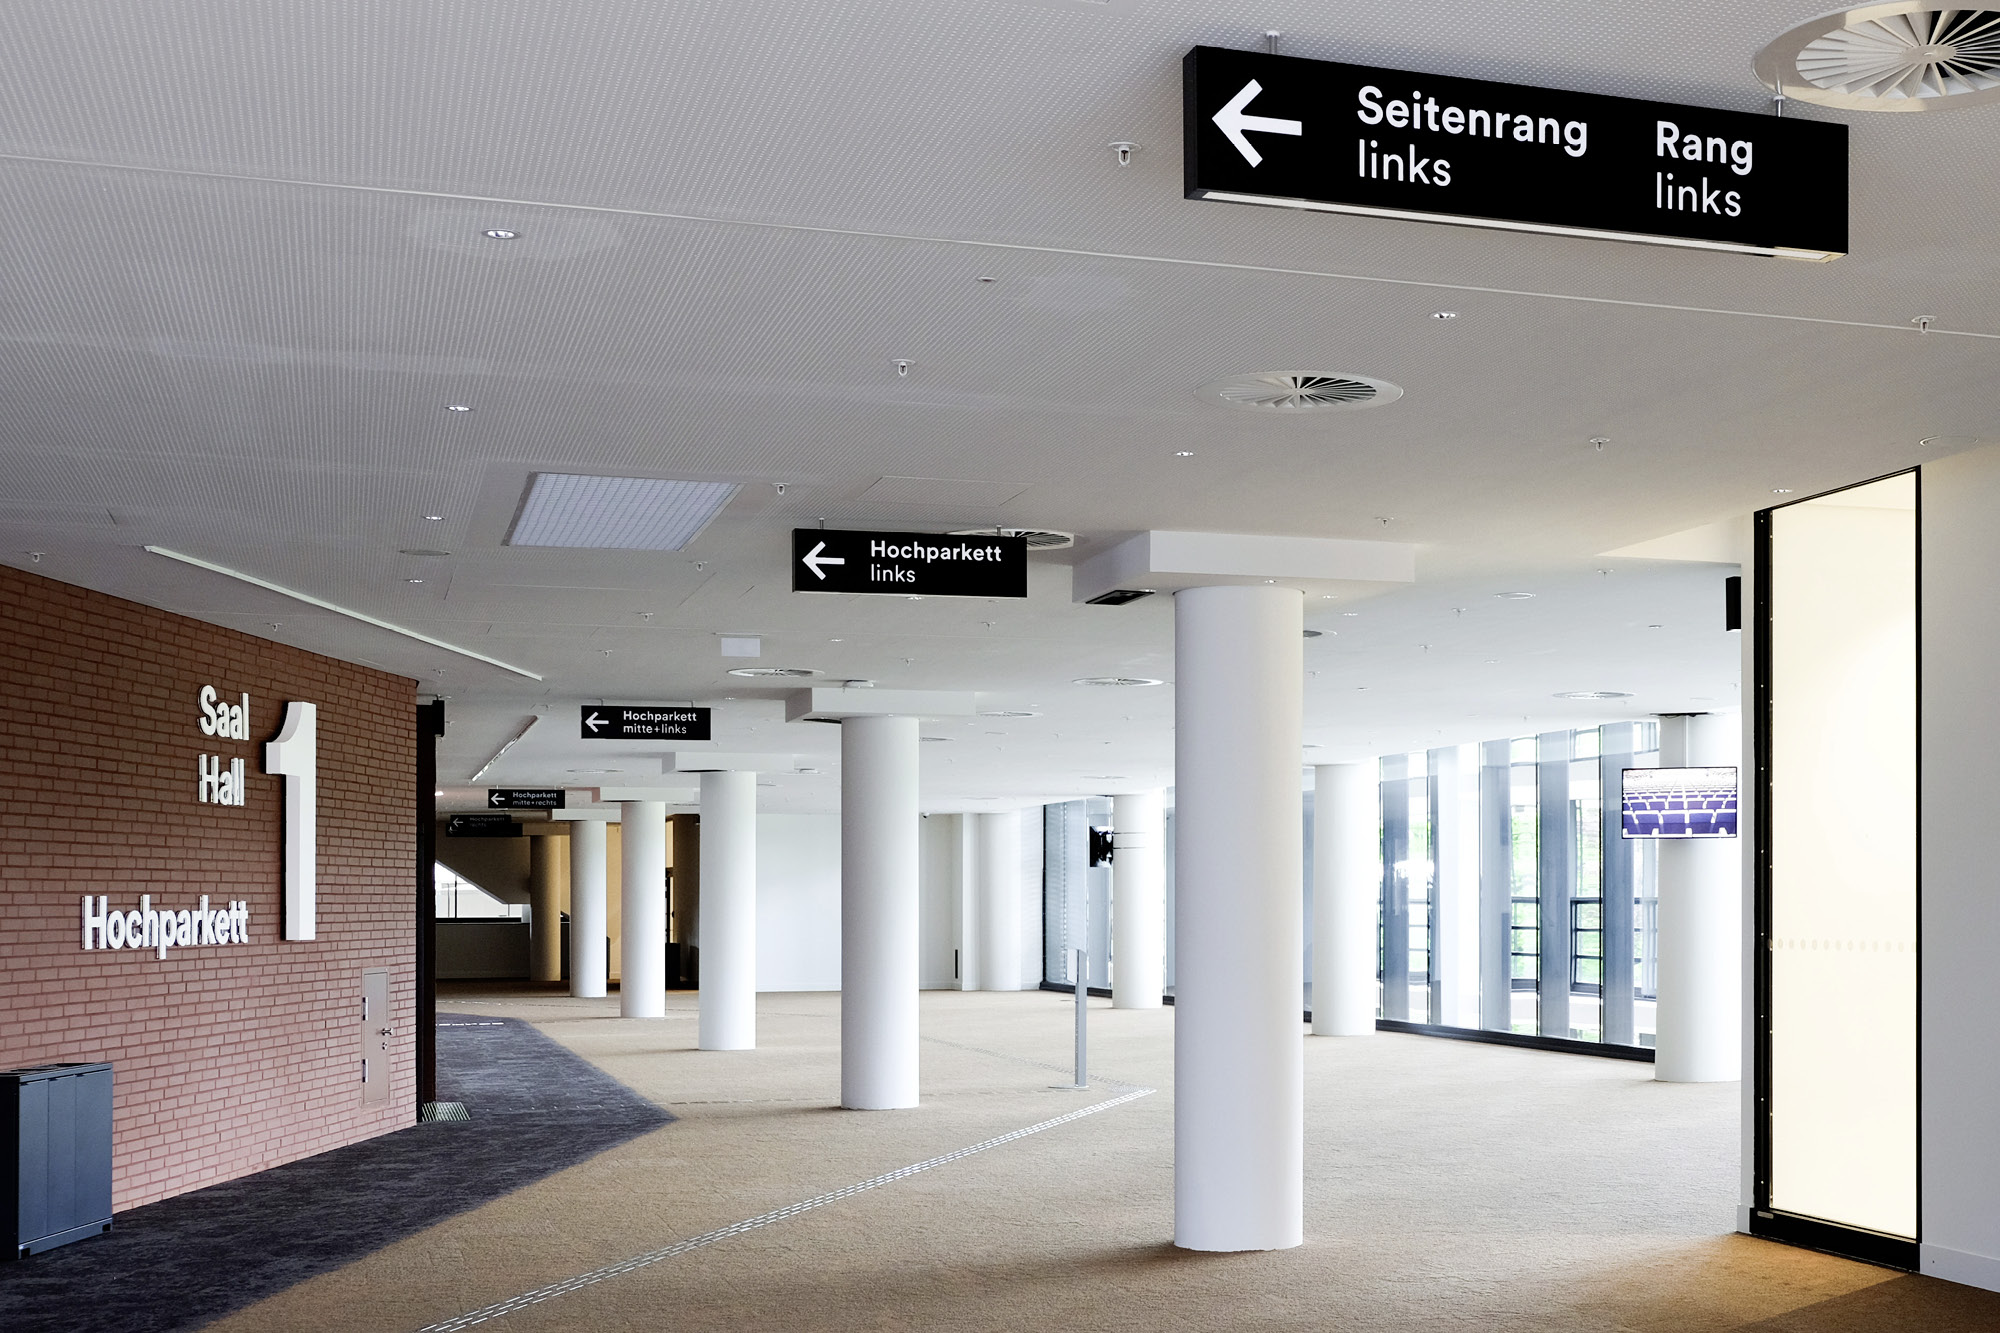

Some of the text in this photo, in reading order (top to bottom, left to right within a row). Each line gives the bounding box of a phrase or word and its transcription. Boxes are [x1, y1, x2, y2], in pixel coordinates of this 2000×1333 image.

[1357, 85, 1588, 158] Seitenrang
[1359, 138, 1451, 187] links
[1656, 120, 1754, 176] Rang
[1656, 171, 1742, 218] links
[870, 540, 1002, 563] Hochparkett
[870, 563, 916, 583] links
[198, 684, 250, 741] Saal
[623, 710, 698, 724] Hochparkett
[199, 753, 245, 806] Hall
[512, 791, 557, 799] Hochparkett
[265, 701, 317, 941] 1
[82, 894, 248, 960] Hochparkett
